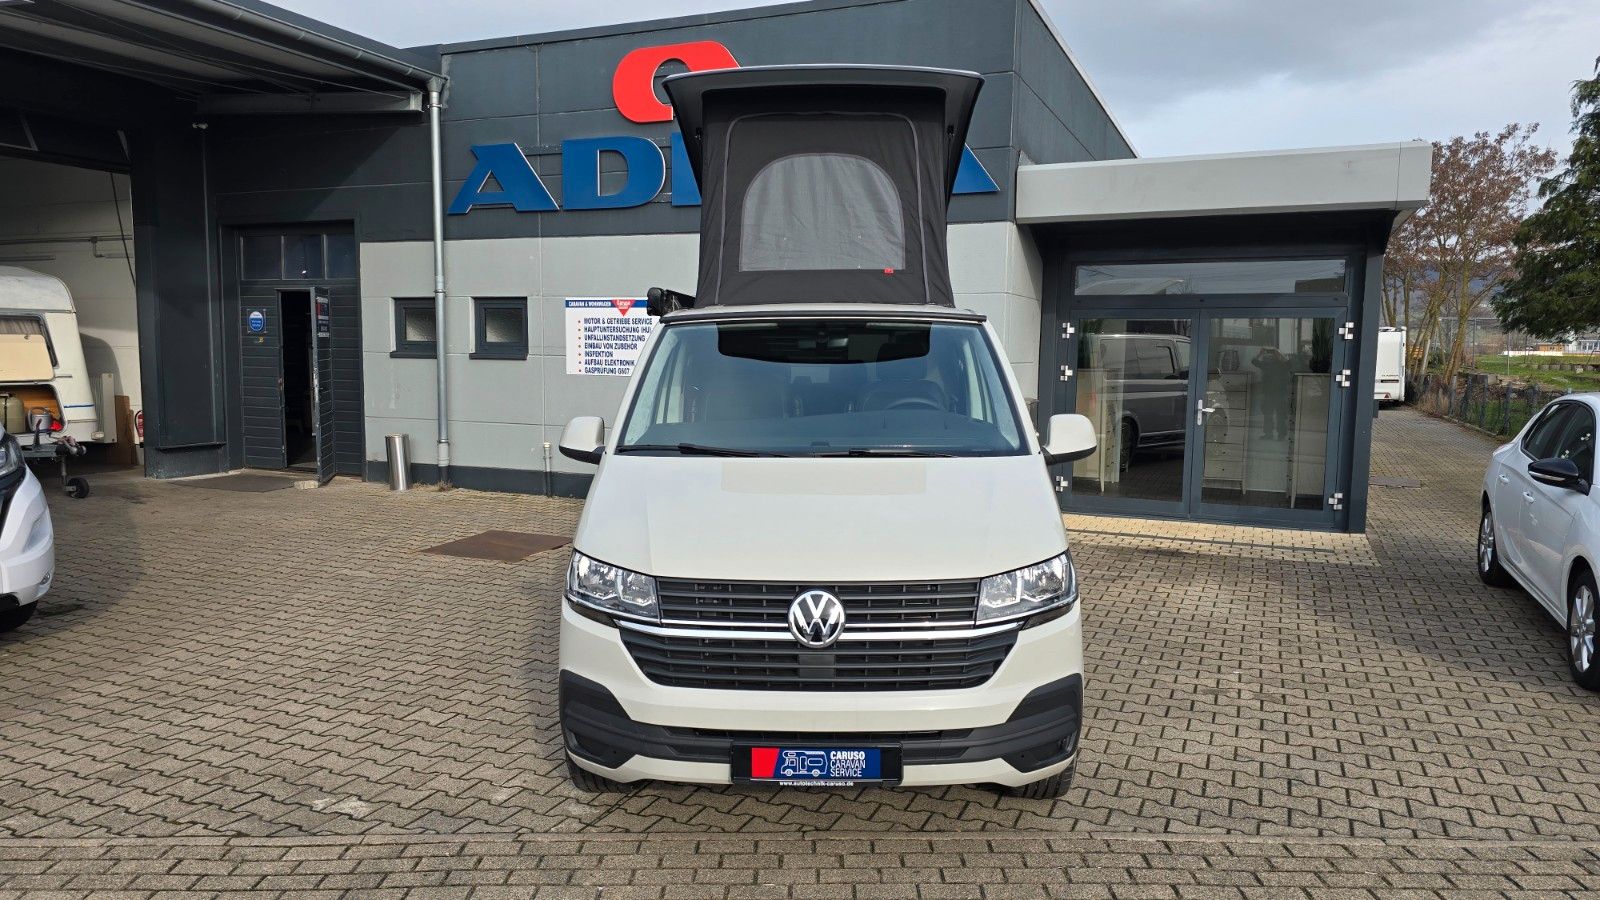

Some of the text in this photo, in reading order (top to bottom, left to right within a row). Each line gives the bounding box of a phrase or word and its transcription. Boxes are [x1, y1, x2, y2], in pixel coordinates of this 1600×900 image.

[584, 334, 646, 342] UNFALLINSTANDSETZUNG
[584, 350, 614, 358] INSPEKTION
[604, 359, 635, 367] ELEKTRONIK
[830, 750, 866, 760] CARUSO
[830, 760, 866, 769] CARAVAN
[830, 768, 862, 777] SERVICE
